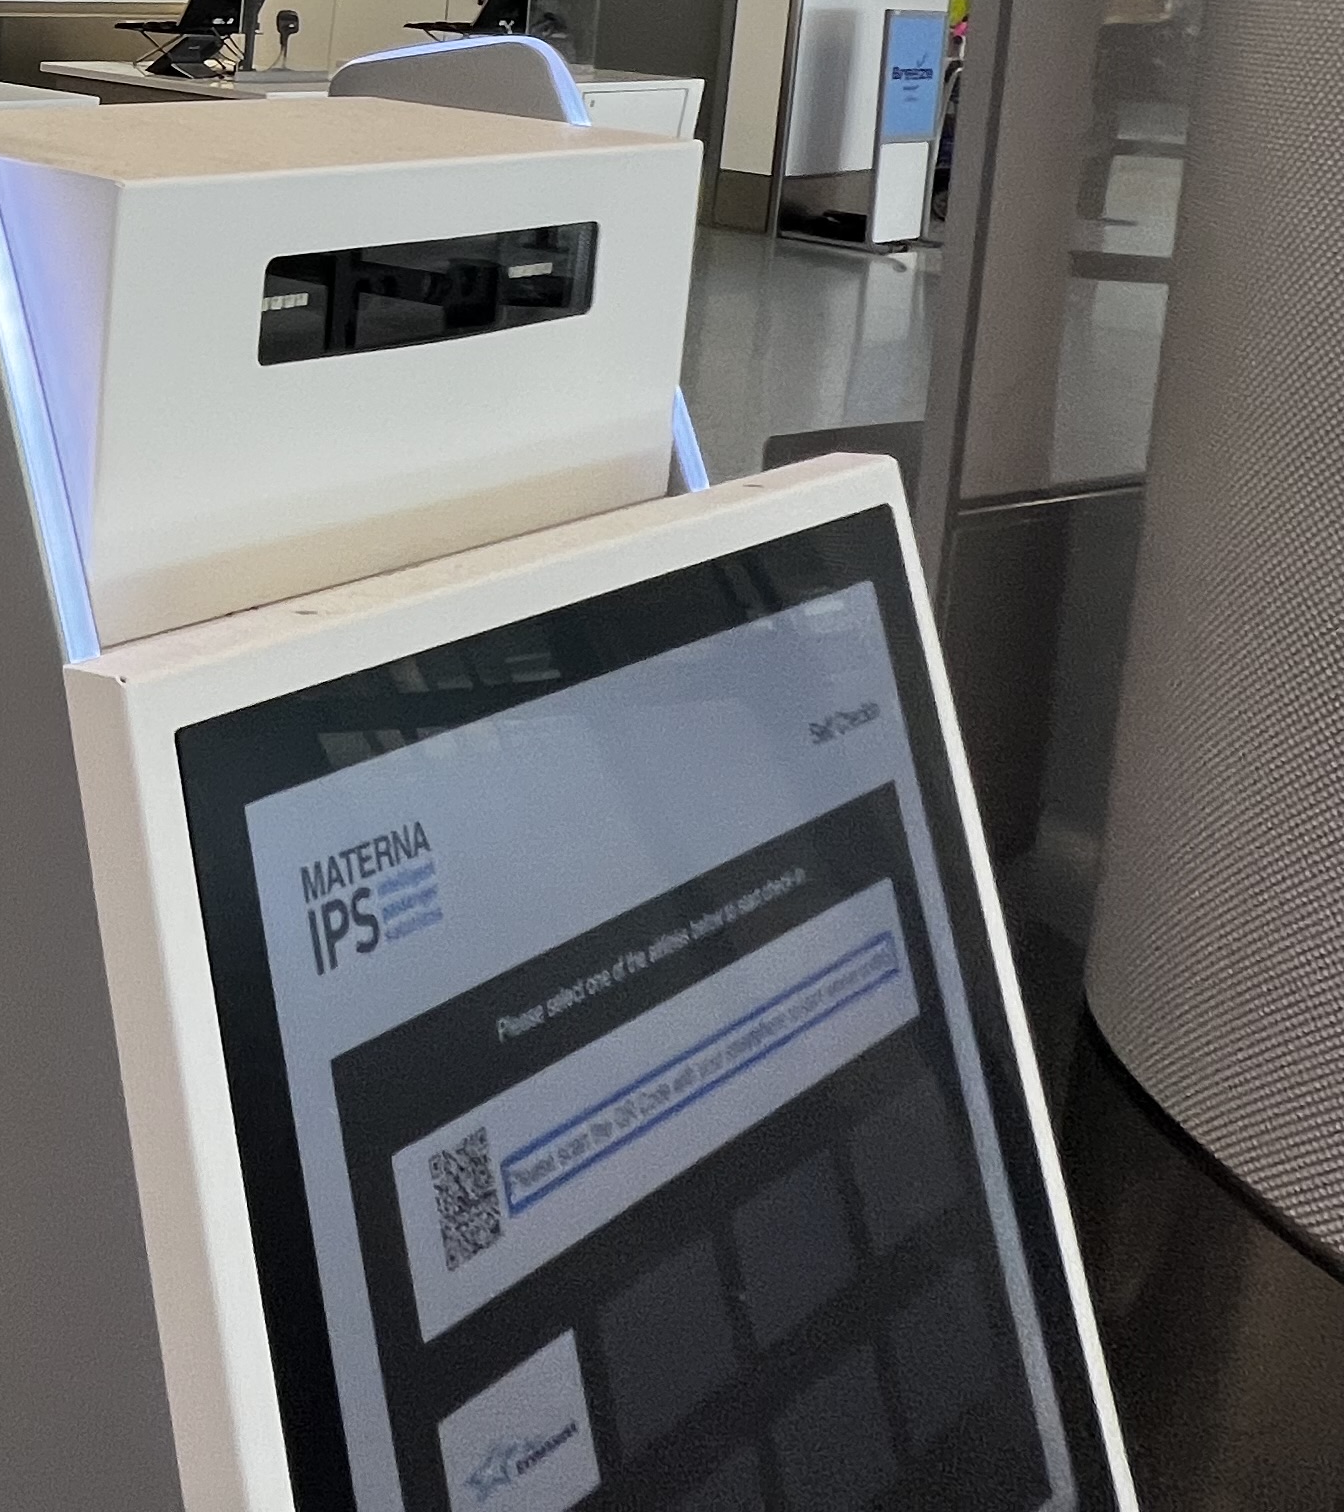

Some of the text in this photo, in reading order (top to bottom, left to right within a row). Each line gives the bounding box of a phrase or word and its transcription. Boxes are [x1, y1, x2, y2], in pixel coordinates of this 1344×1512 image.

[300, 821, 432, 904] MATERNA
[308, 887, 380, 976] IPS
[496, 1004, 545, 1044] Please
